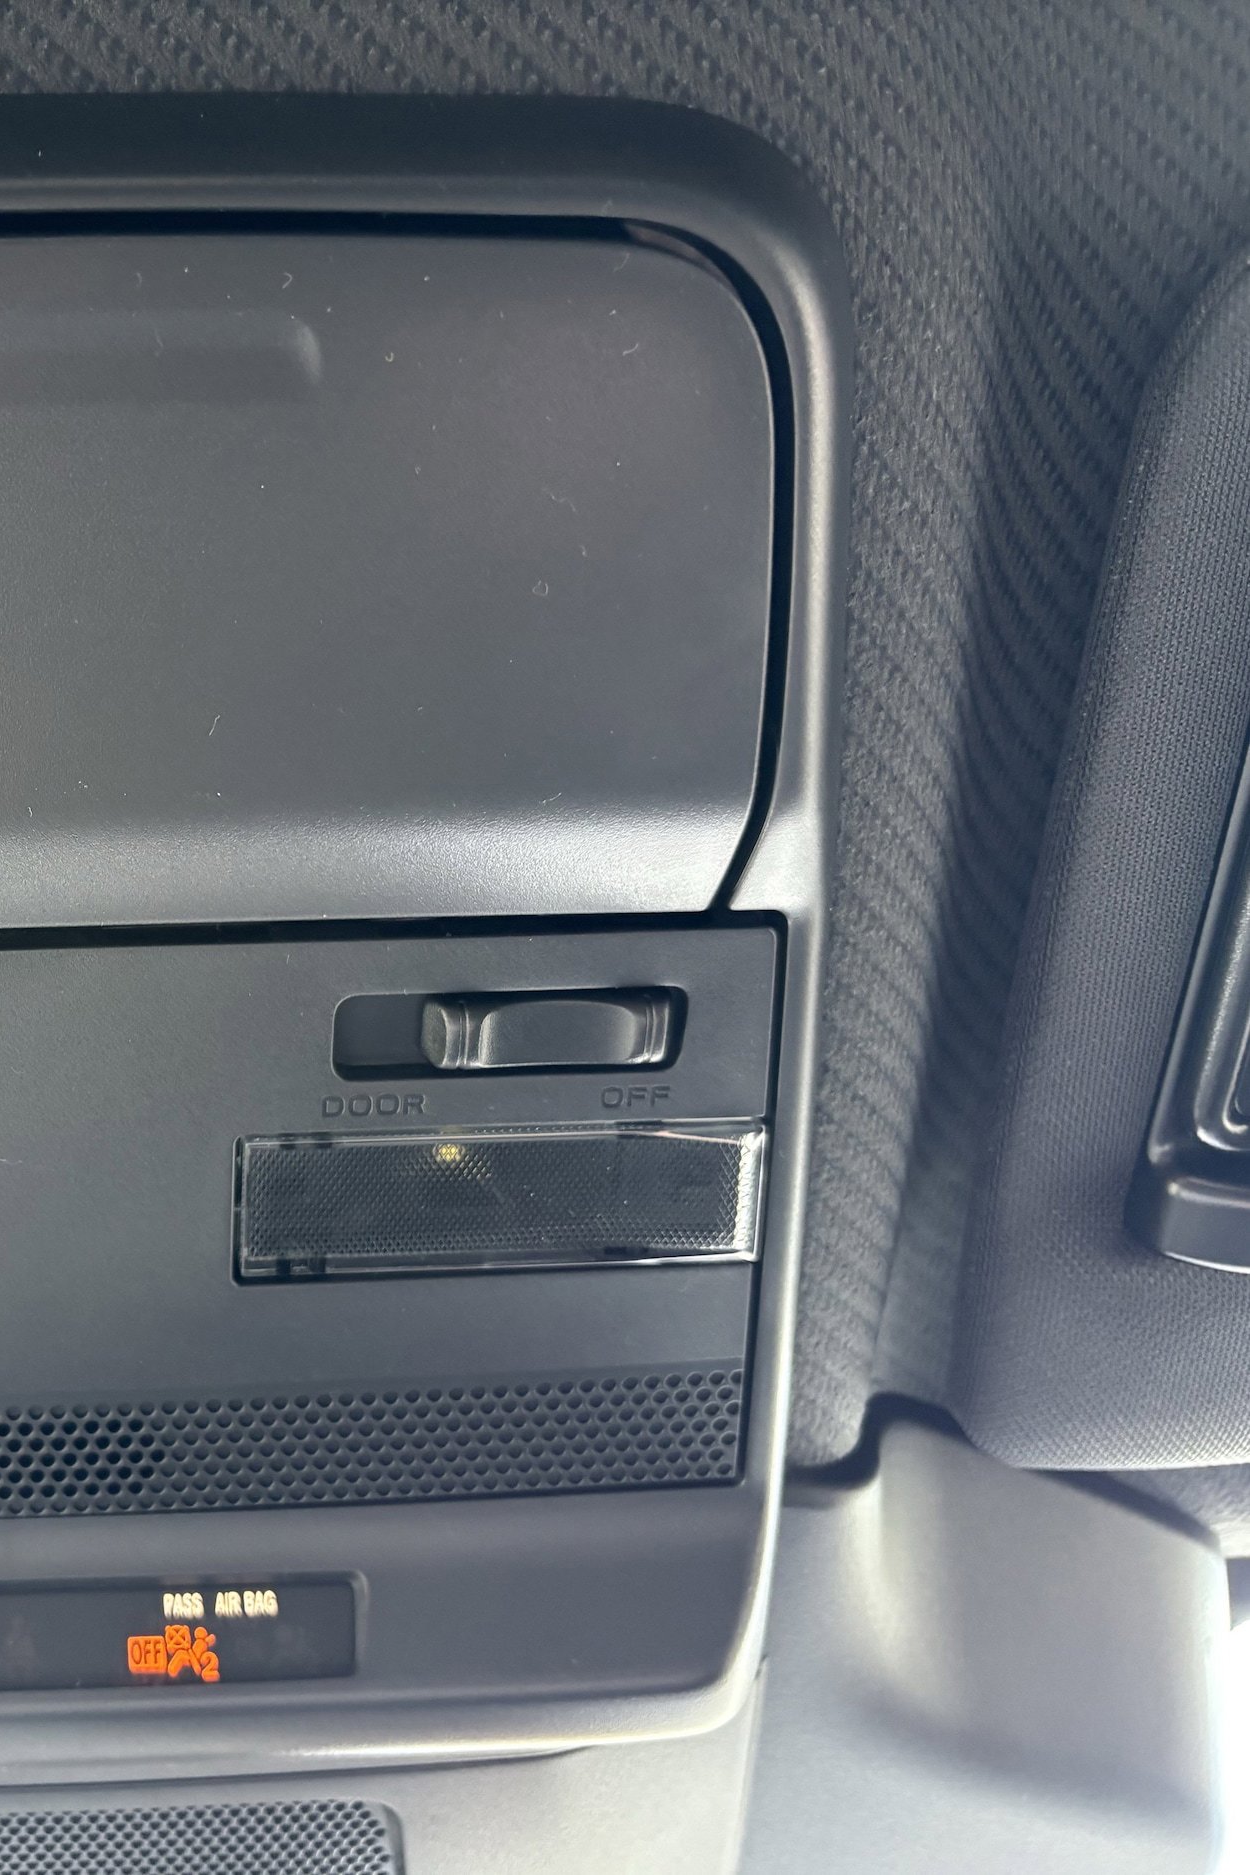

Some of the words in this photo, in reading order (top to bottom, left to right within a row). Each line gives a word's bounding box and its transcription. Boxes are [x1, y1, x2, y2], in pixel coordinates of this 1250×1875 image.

[320, 1093, 427, 1120] DOOR
[600, 1085, 672, 1110] OFF
[162, 1592, 205, 1620] PASS
[214, 1591, 243, 1618] AIR
[243, 1589, 279, 1618] BAG
[130, 1640, 162, 1666] OFF
